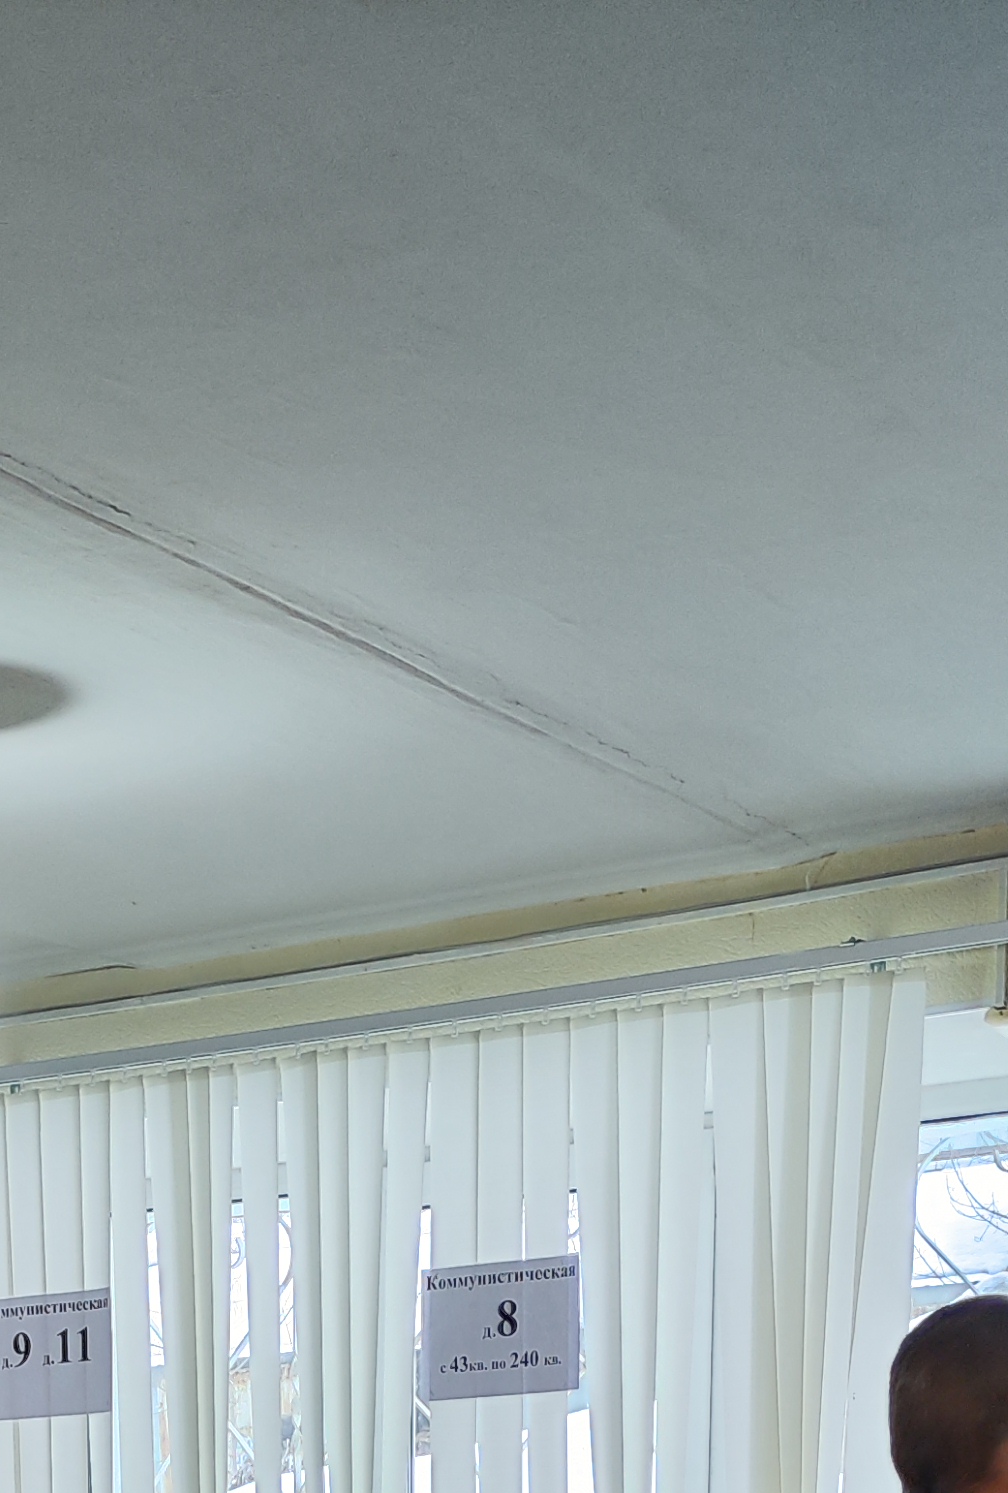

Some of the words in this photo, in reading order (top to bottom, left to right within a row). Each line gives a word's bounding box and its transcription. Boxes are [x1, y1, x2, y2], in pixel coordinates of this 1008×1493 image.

[426, 1265, 576, 1291] Коммунистическая
[482, 1300, 518, 1339] д.8
[1, 1332, 32, 1370] д.9
[42, 1326, 92, 1366] д.11
[491, 1360, 506, 1370] по
[510, 1350, 539, 1368] 240
[544, 1356, 562, 1367] кв.
